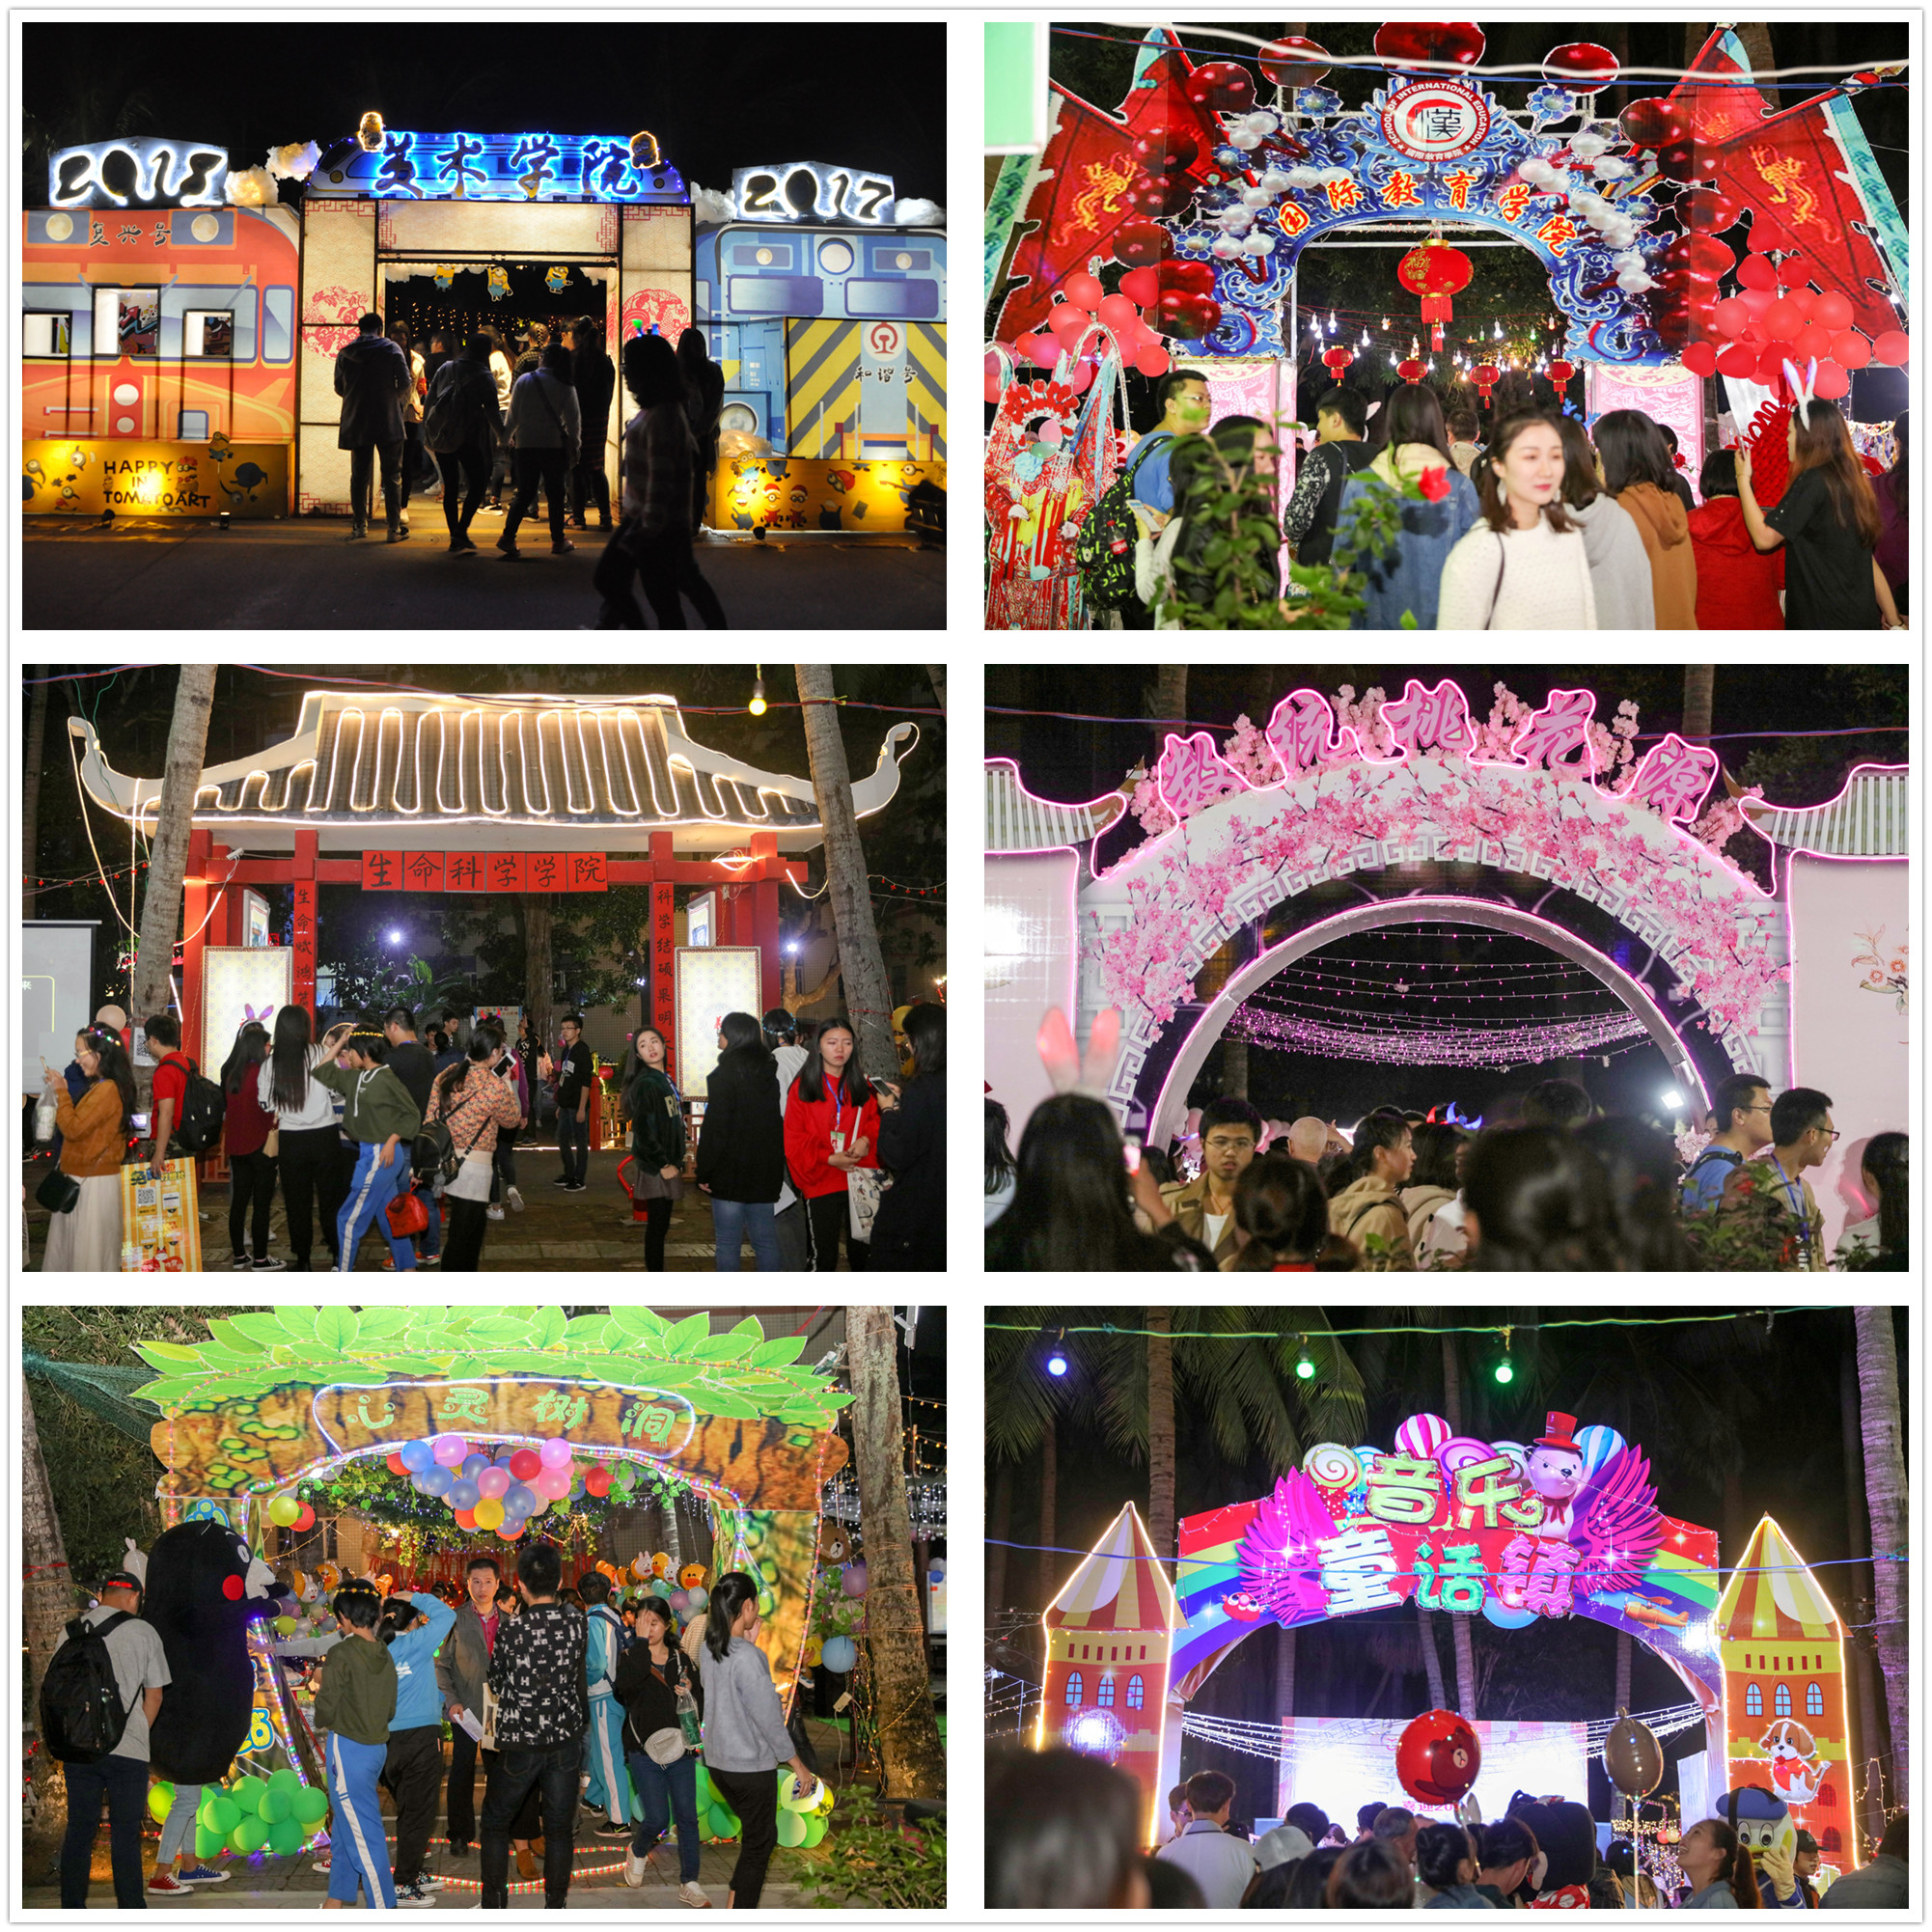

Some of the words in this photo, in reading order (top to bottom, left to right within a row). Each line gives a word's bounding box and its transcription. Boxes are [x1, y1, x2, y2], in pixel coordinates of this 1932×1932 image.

[1387, 98, 1396, 111] OF
[1395, 82, 1475, 101] INTERNATIONAL
[1384, 112, 1400, 145] SCHOOL
[1469, 98, 1487, 146] EDUCATION
[374, 132, 639, 201] 美术学院
[739, 165, 895, 224] 2017
[1279, 171, 1578, 257] 国际教育学院
[89, 221, 172, 247] 复兴号
[854, 364, 919, 385] 和谐号
[103, 459, 175, 475] HAPPY
[131, 476, 148, 487] IN
[365, 850, 607, 889] 生命科学学院
[656, 890, 676, 1073] 科学结硕果明
[346, 1387, 676, 1449] 心灵树洞
[1365, 1449, 1545, 1530] 音乐
[1316, 1529, 1585, 1619] 童话镇
